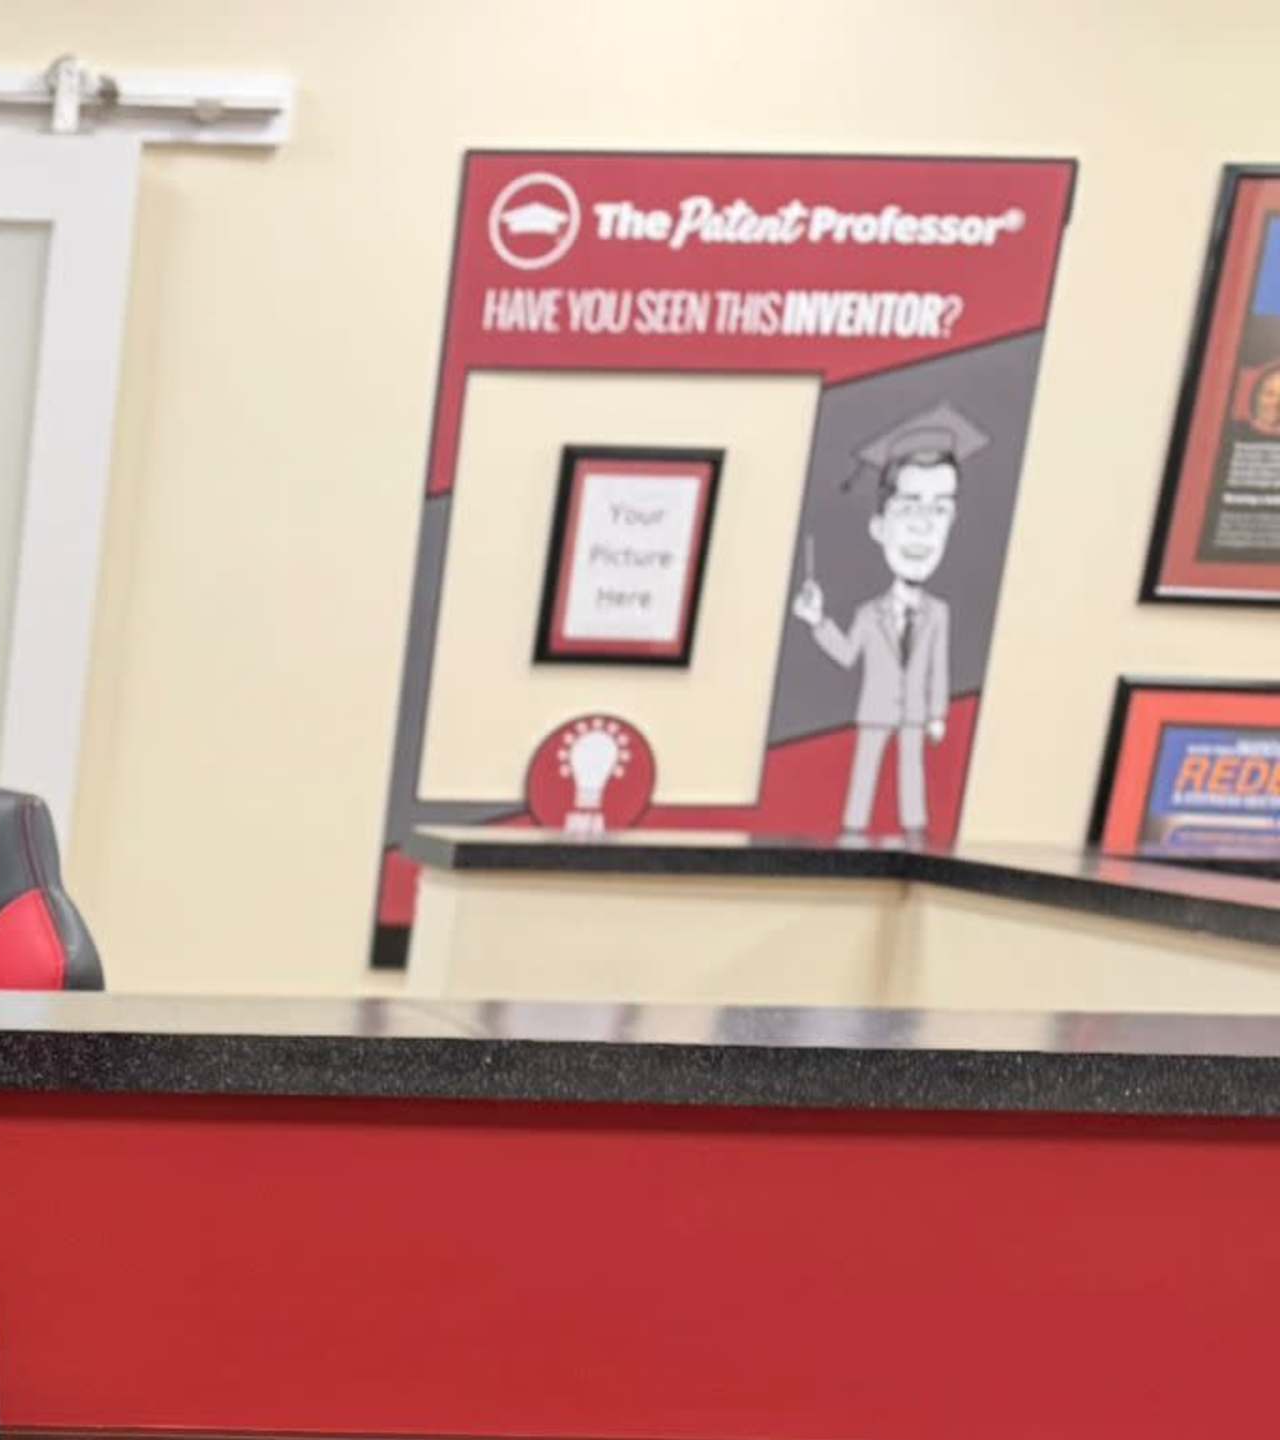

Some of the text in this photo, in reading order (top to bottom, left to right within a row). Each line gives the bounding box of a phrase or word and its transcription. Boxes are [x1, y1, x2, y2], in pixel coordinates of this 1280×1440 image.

[594, 201, 672, 241] The
[669, 195, 809, 249] Patent
[482, 288, 965, 339] HAVE YOU SEEN THIS INVENTOR?
[610, 503, 666, 526] Your
[589, 541, 674, 569] Picture
[595, 586, 653, 609] Here
